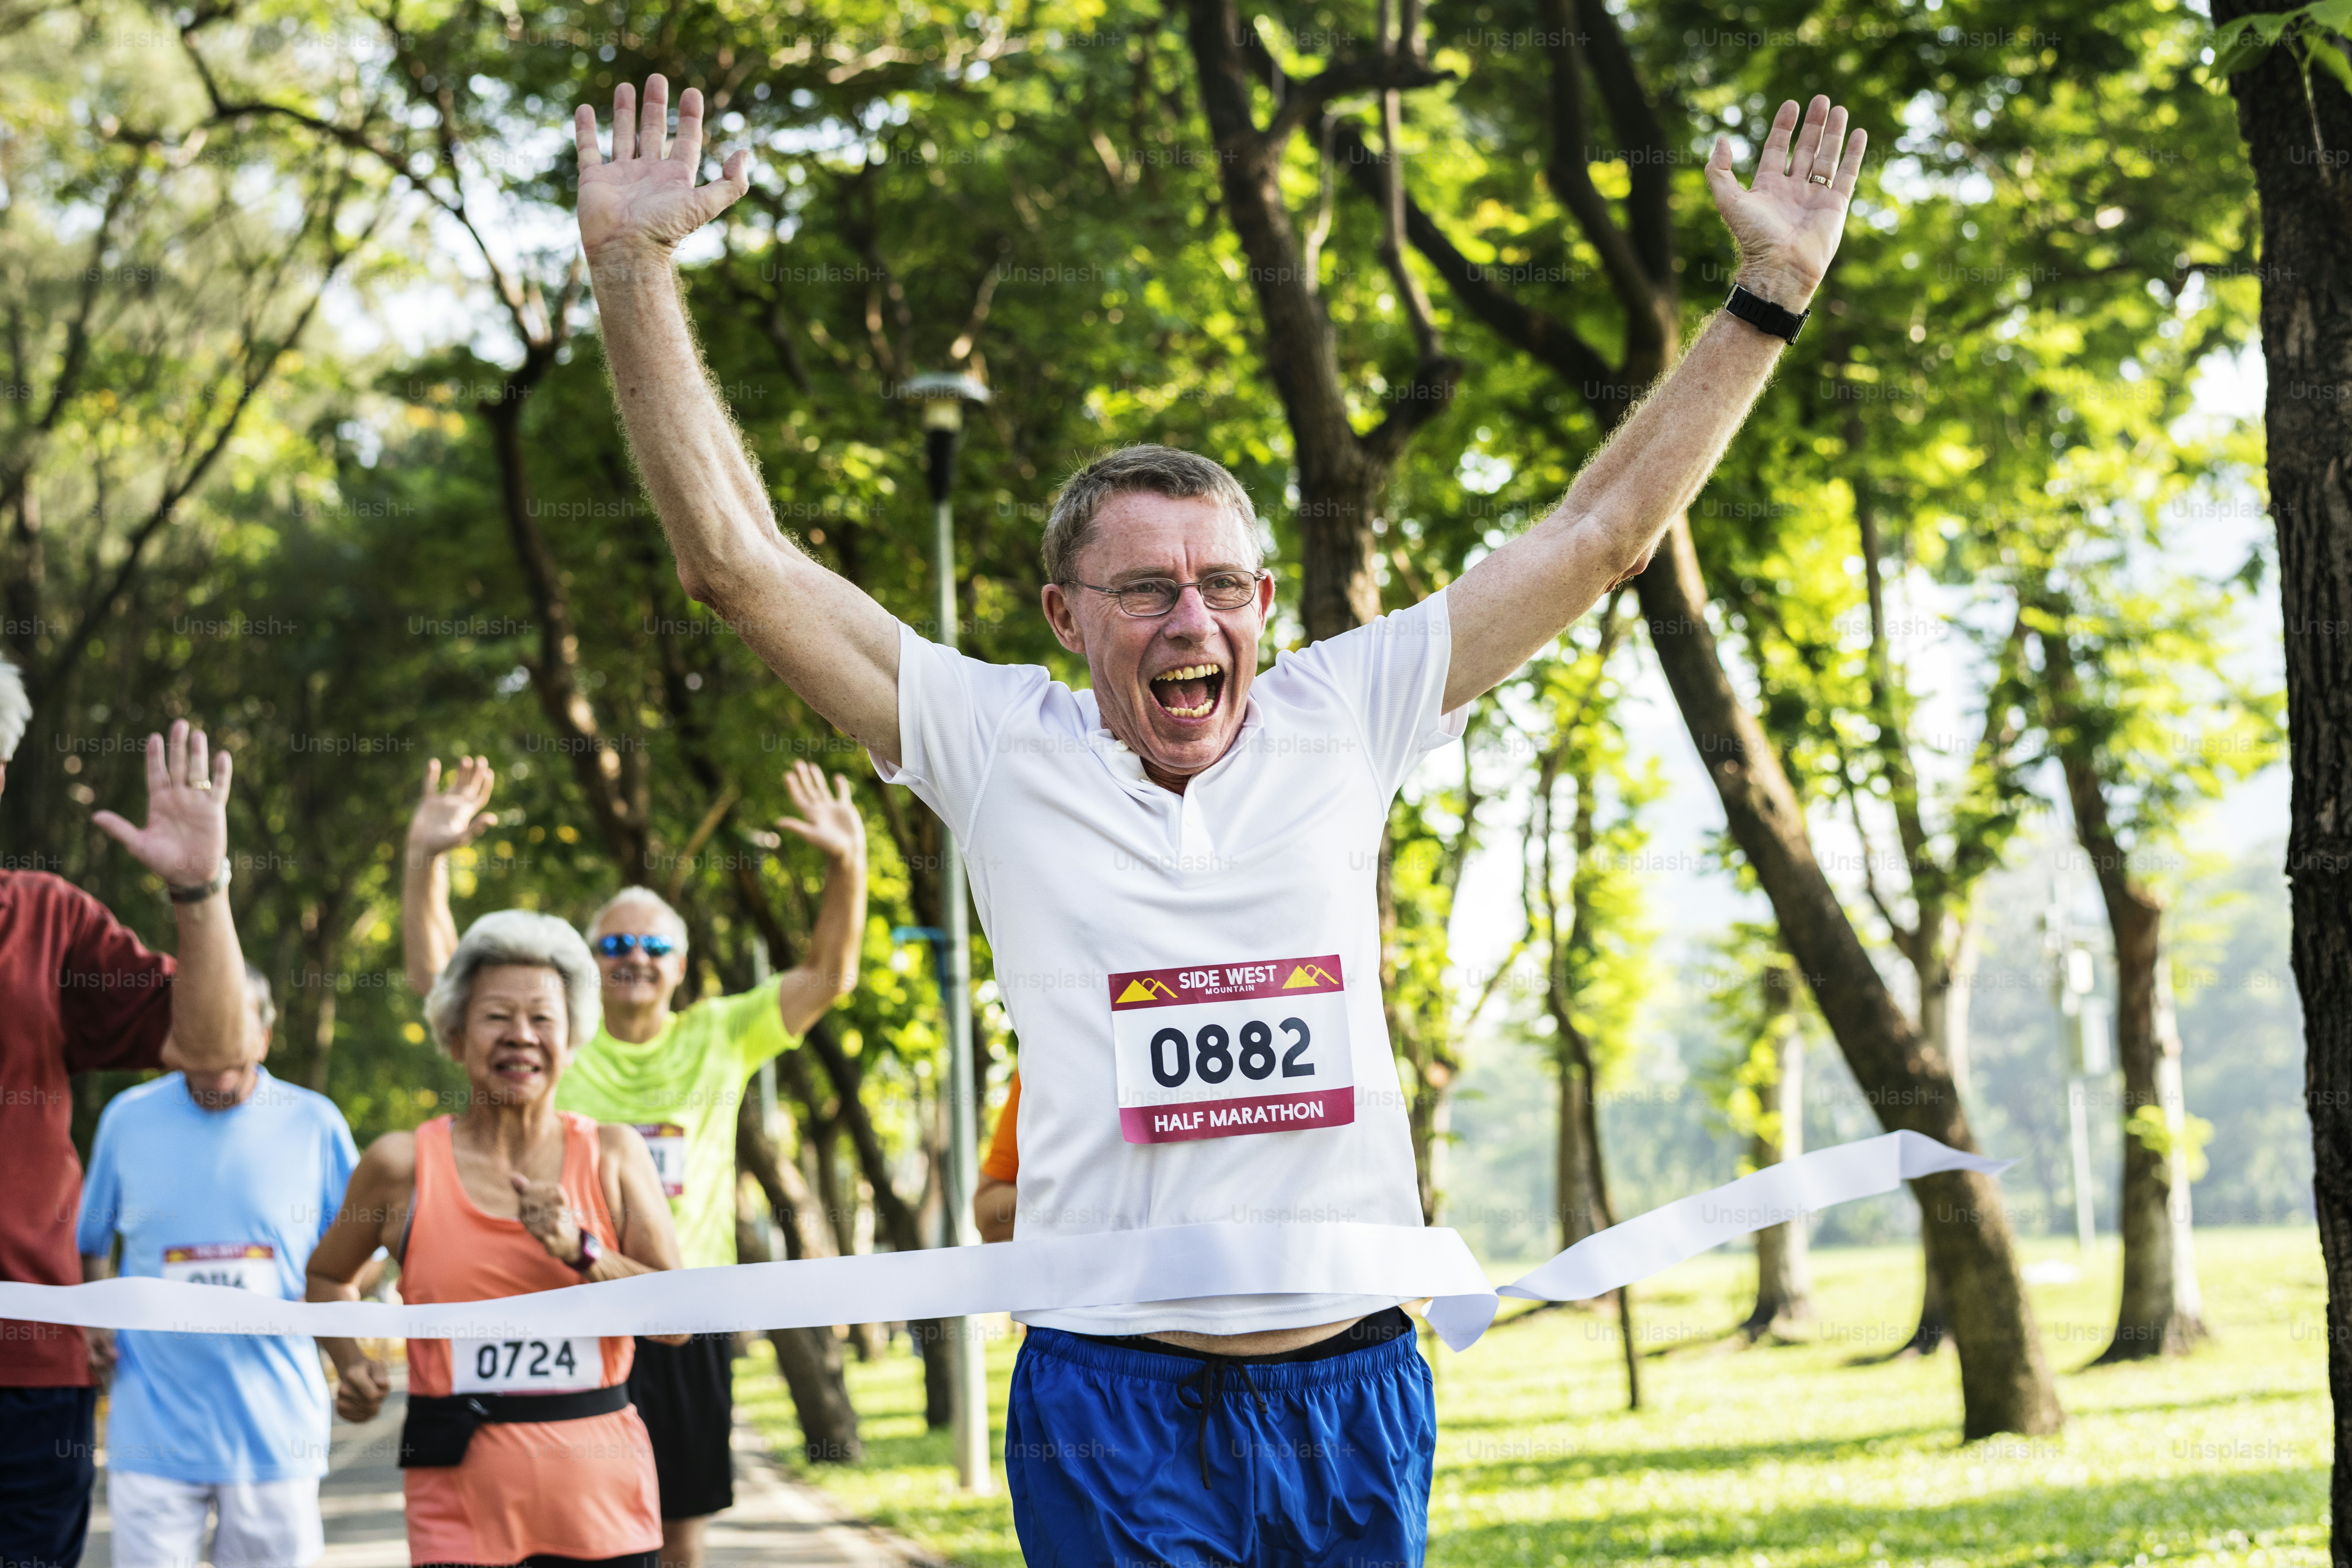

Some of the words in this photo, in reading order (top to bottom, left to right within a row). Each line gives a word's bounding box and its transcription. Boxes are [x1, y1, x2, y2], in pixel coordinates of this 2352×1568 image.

[1179, 969, 1220, 989] SIDE
[1226, 965, 1277, 985] WEST
[1205, 985, 1255, 994] MOUNTAIN
[1150, 1017, 1315, 1088] 0882
[1154, 1112, 1204, 1132] HALF
[1210, 1100, 1324, 1127] MARATHON
[477, 1340, 576, 1379] 0724
